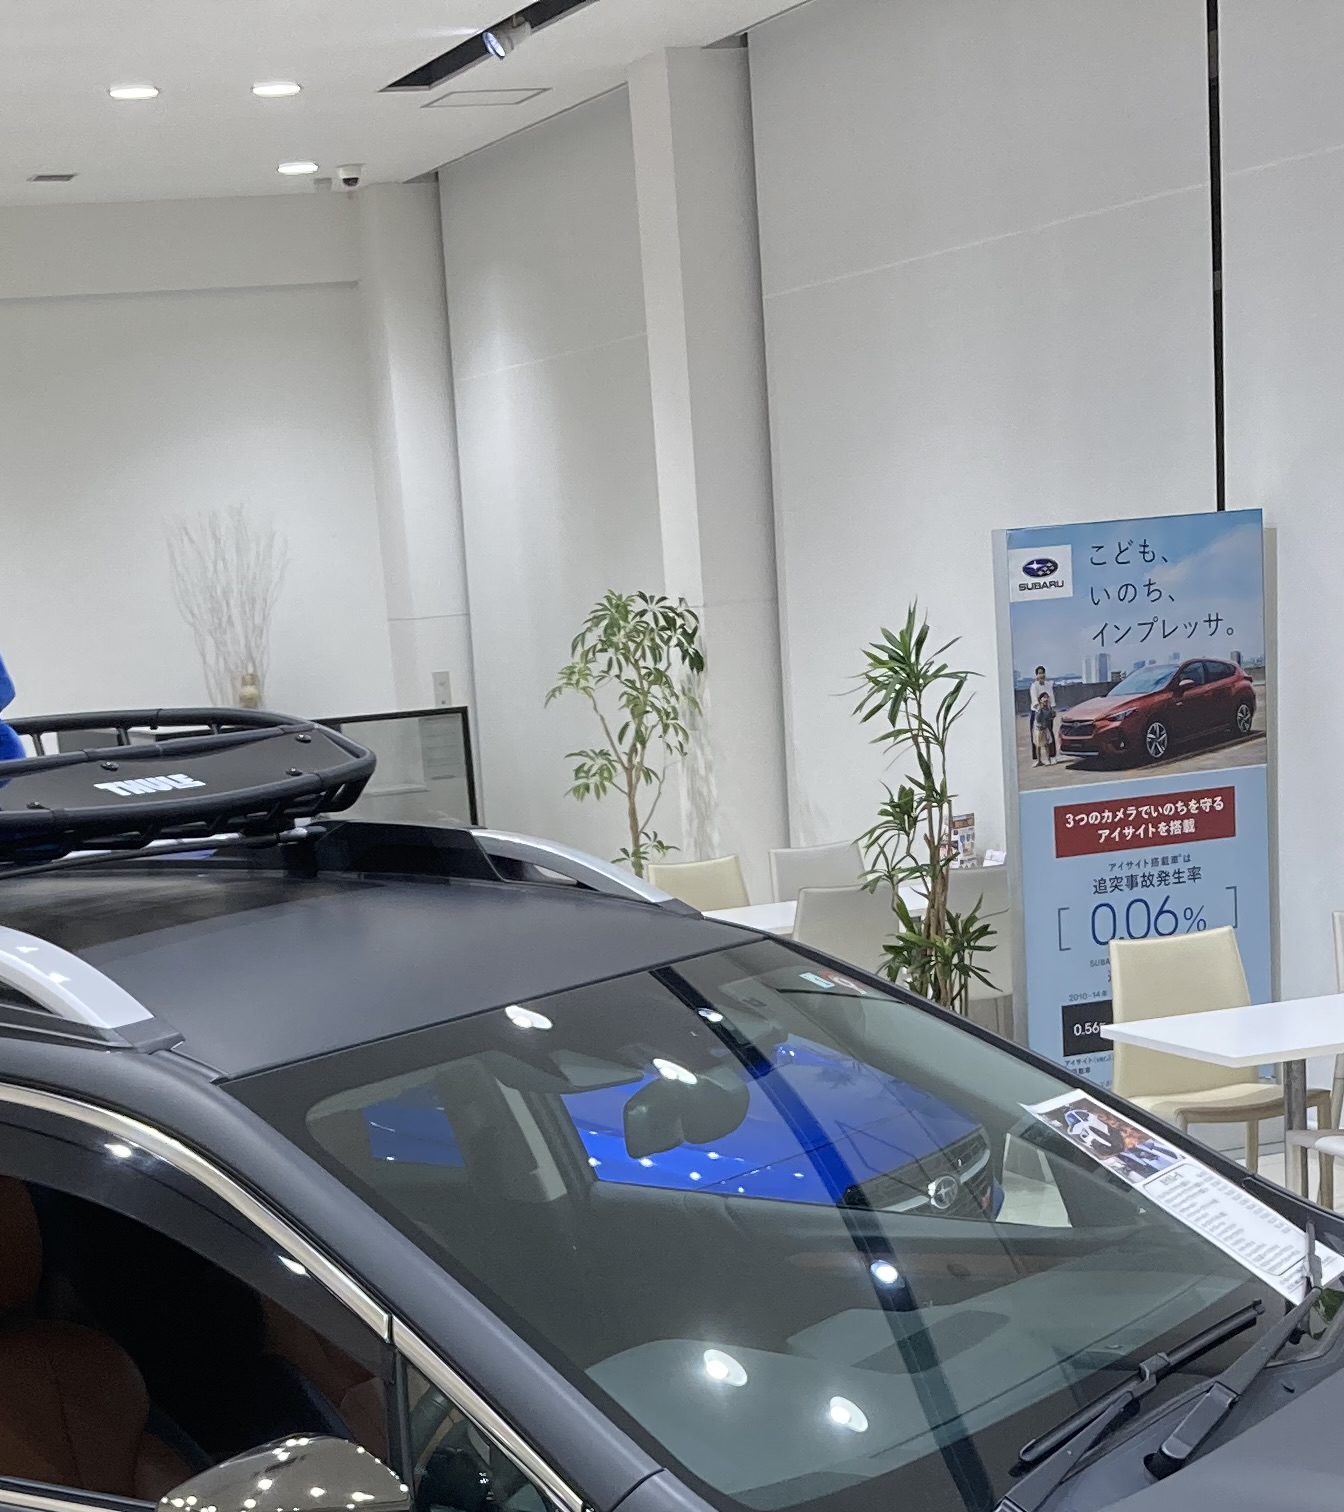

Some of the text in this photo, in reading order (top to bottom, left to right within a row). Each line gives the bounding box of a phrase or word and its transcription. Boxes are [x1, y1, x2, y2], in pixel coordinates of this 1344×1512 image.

[1089, 538, 1169, 566] こども、
[1018, 579, 1065, 592] SUBARU
[1090, 578, 1176, 606] いのち、
[1092, 612, 1235, 647] インプレッサ。
[93, 773, 207, 796] THULE
[1065, 796, 1225, 828] 3つのカメラでいのちを守る
[1097, 818, 1196, 843] アイサイトを搭載
[1092, 865, 1203, 895] 追突事故発生率
[1073, 1020, 1105, 1037] 0.56
